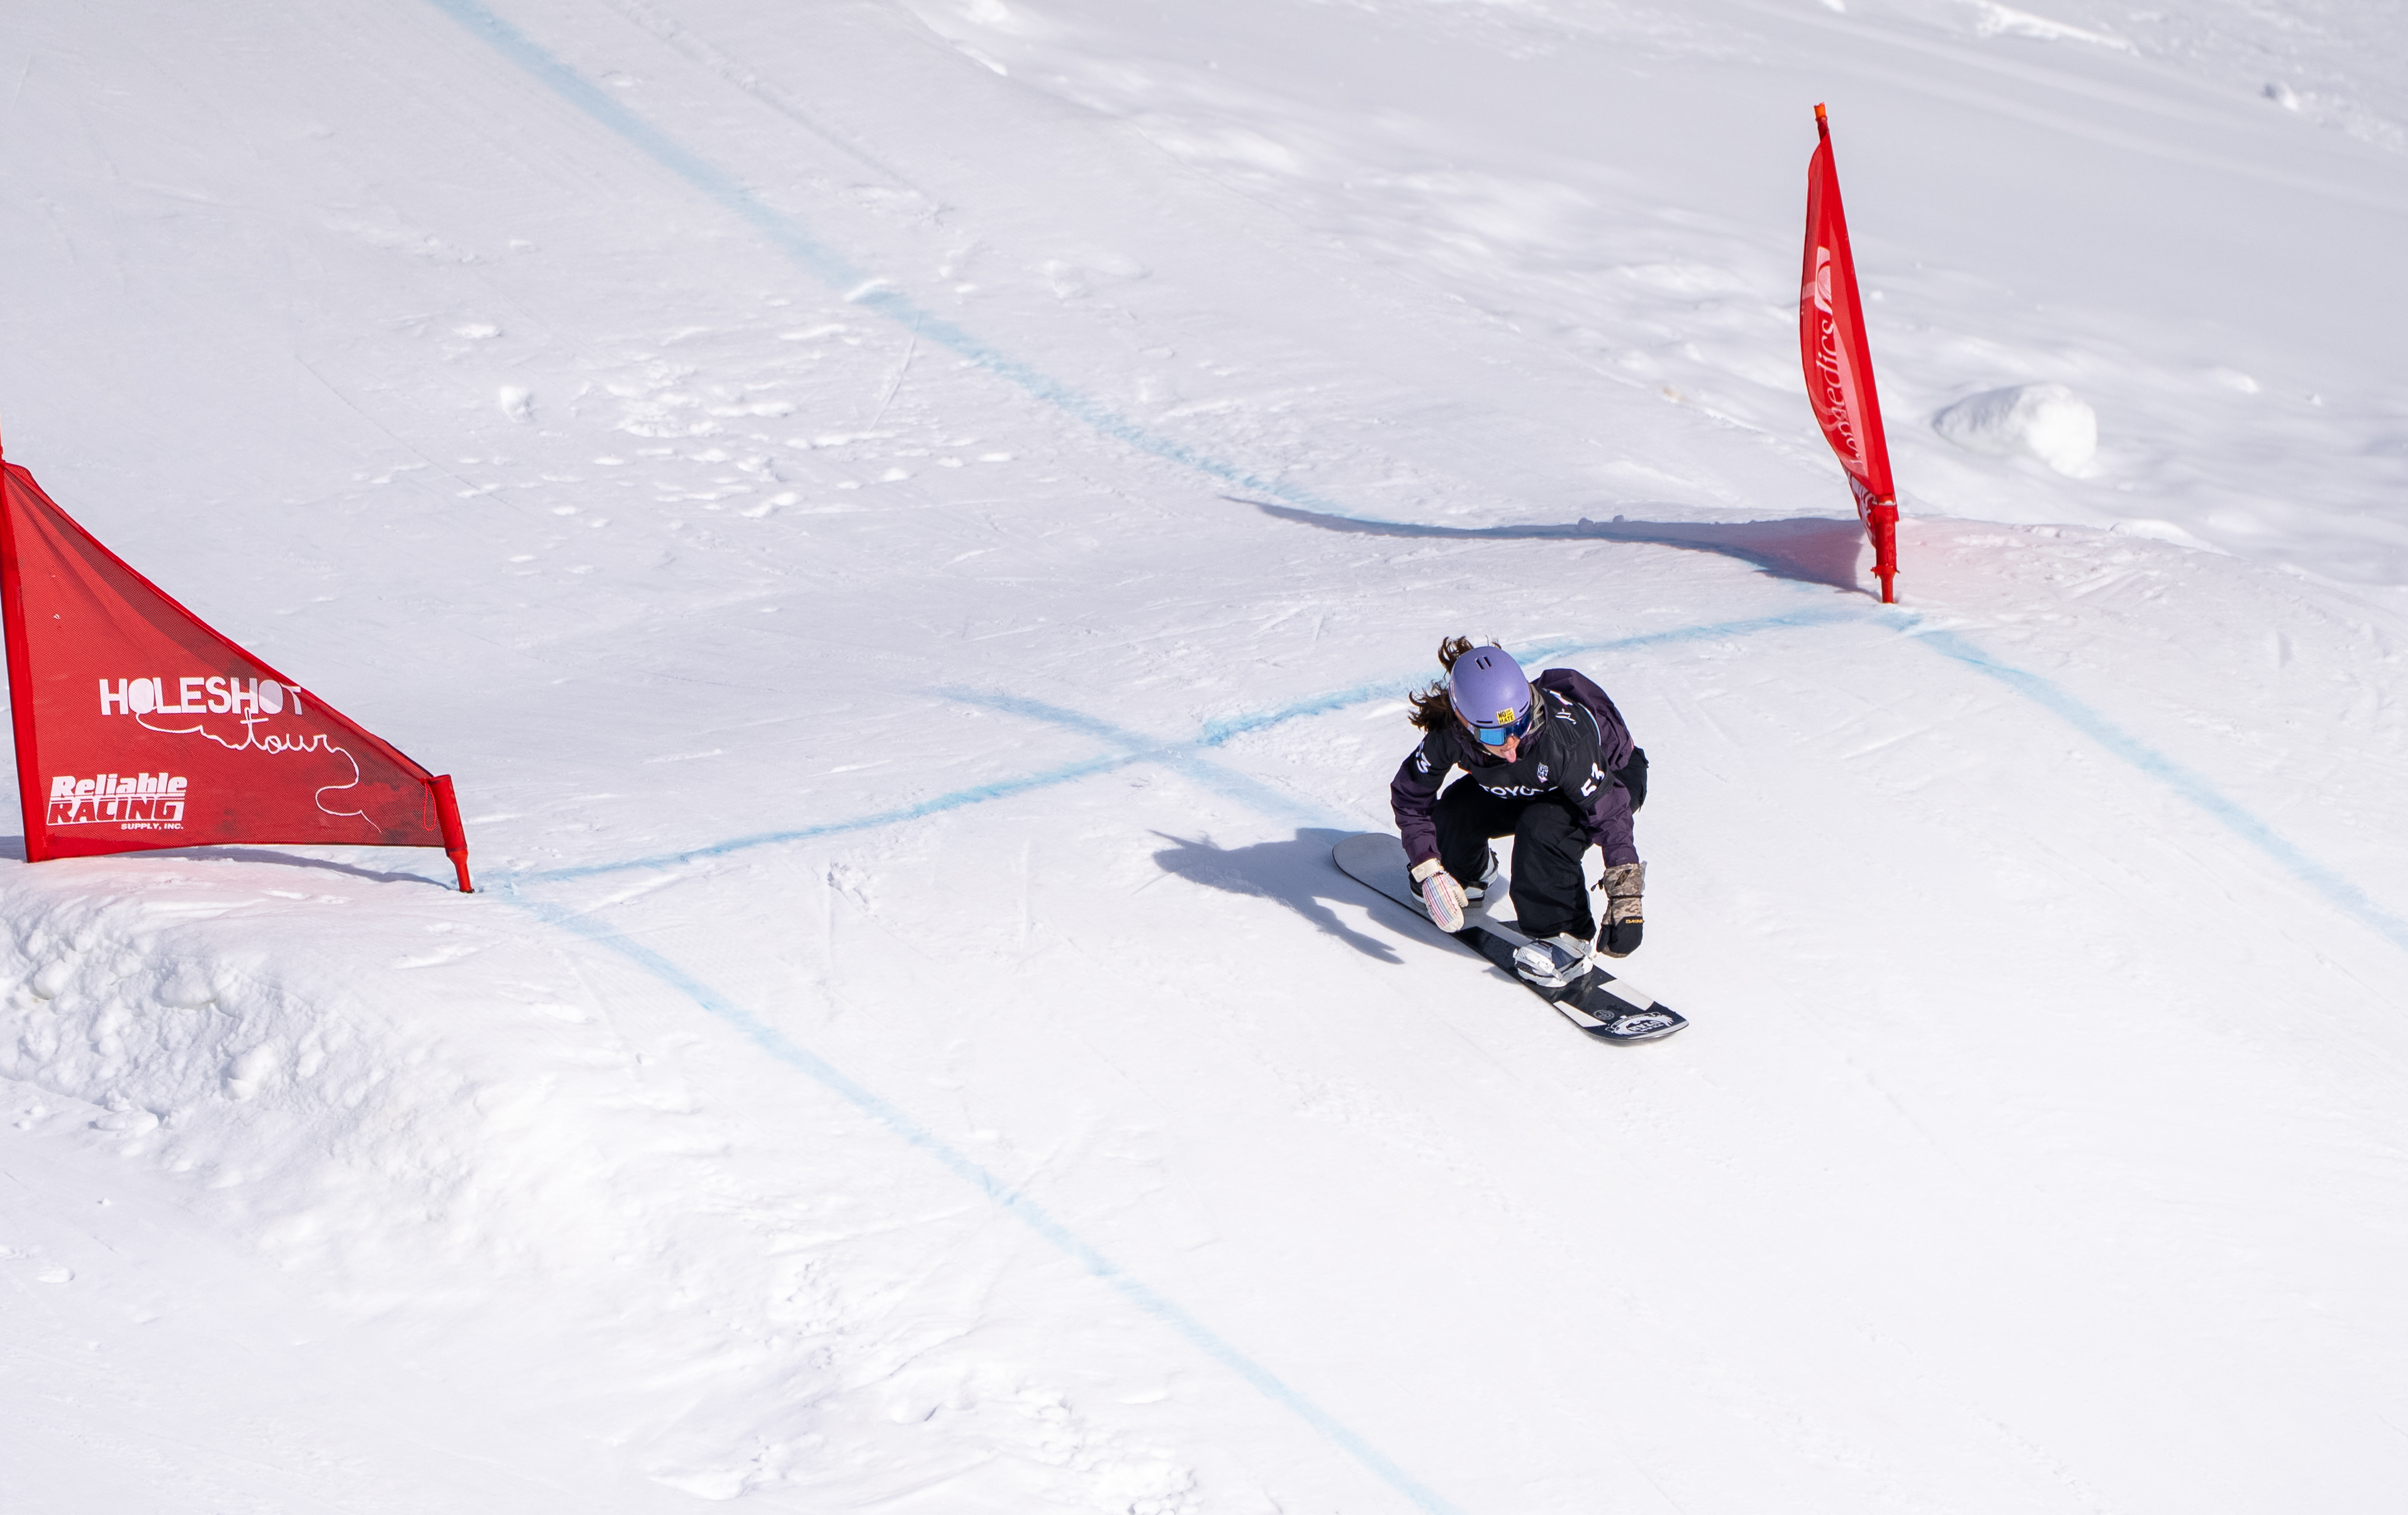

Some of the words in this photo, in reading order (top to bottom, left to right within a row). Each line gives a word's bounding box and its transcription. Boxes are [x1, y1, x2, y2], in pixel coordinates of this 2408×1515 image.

[99, 677, 303, 715] HOLESHOT
[239, 707, 328, 754] tour
[1499, 714, 1514, 724] HATE
[50, 772, 187, 797] Reliable
[47, 795, 185, 825] RACING
